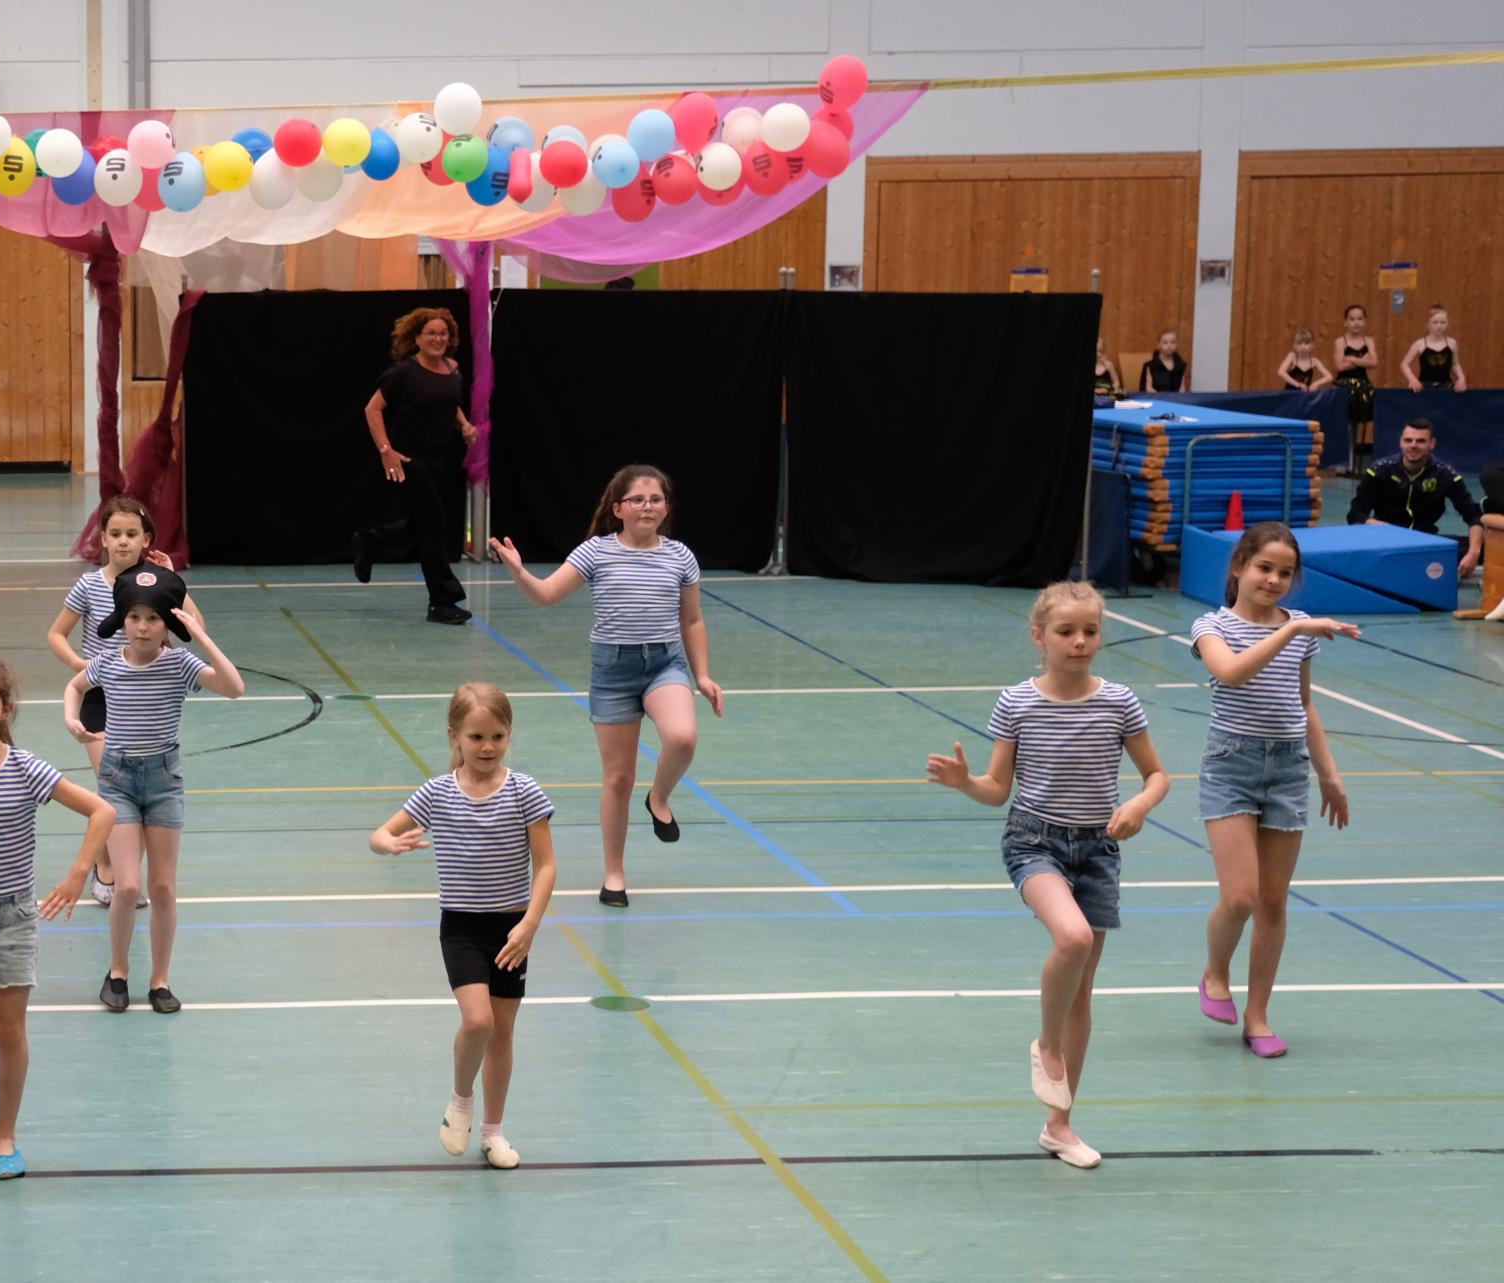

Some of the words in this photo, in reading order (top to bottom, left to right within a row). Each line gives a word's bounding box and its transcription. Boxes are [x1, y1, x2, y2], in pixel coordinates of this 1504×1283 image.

[3, 155, 23, 173] S
[104, 157, 125, 172] S
[163, 161, 184, 177] S
[752, 154, 771, 173] S
